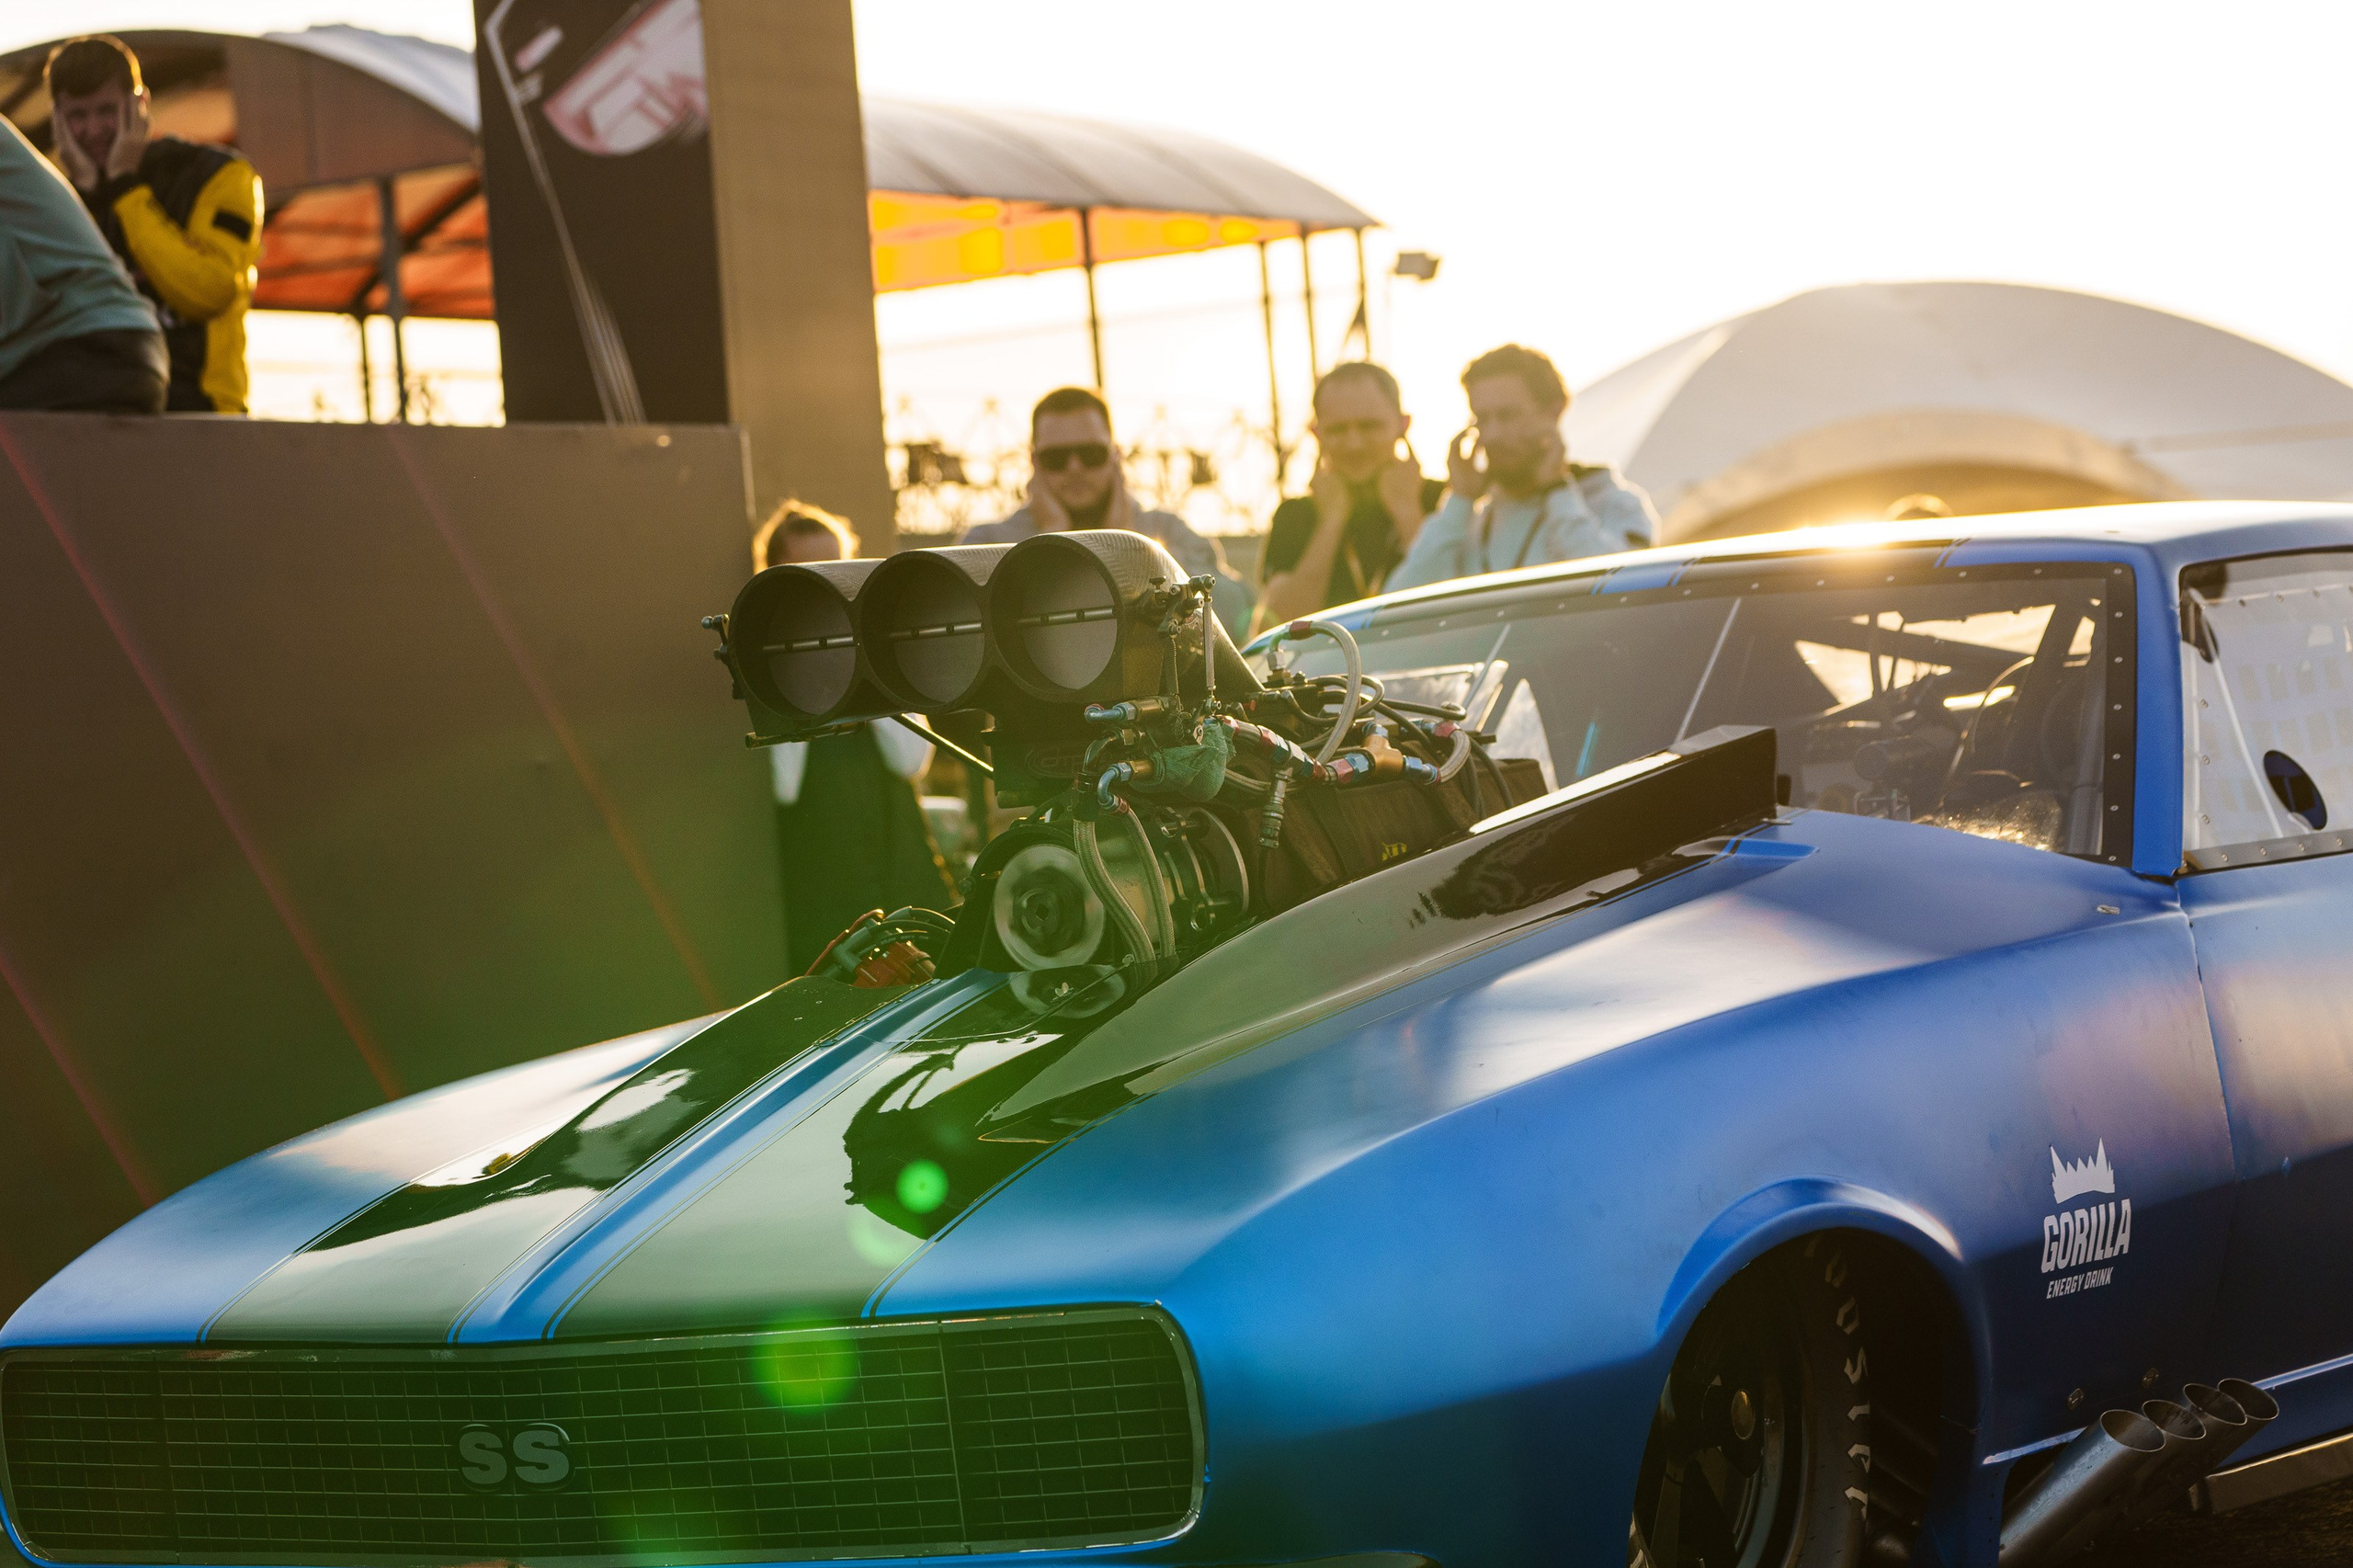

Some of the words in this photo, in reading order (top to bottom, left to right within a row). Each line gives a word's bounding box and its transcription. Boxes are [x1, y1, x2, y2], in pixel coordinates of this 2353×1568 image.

[2041, 1199, 2131, 1274] GORILLA
[2046, 1274, 2085, 1300] ENERGY
[2084, 1267, 2114, 1290] DRINK
[459, 1428, 570, 1486] SS
